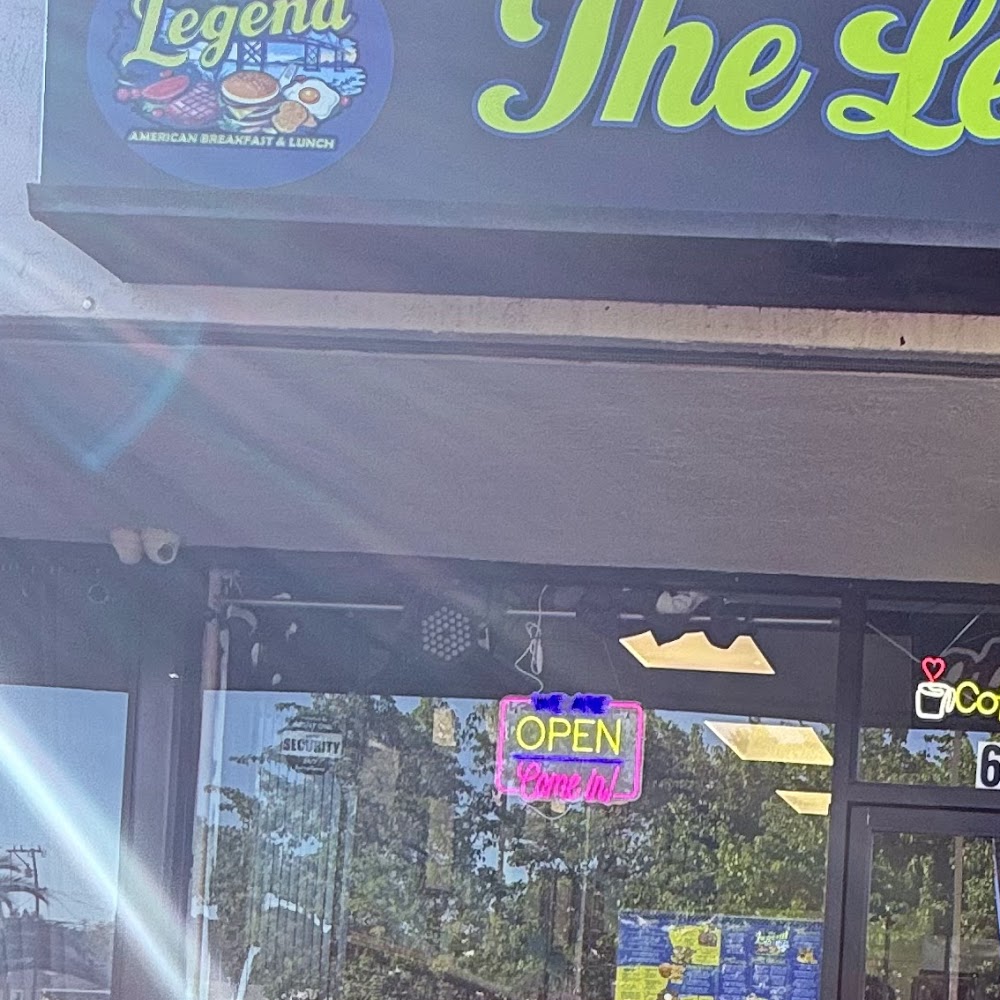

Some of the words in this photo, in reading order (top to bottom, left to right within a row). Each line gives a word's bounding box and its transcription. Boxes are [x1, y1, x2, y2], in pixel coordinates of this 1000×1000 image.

[122, 0, 351, 68] Legend
[477, 0, 811, 133] The
[129, 131, 197, 143] AMERICAN
[200, 133, 274, 146] BREAKFAST
[276, 136, 285, 147] &
[289, 138, 334, 149] LUNCH
[283, 738, 341, 754] SECURITY
[516, 715, 622, 755] OPEN
[517, 761, 582, 799] Come
